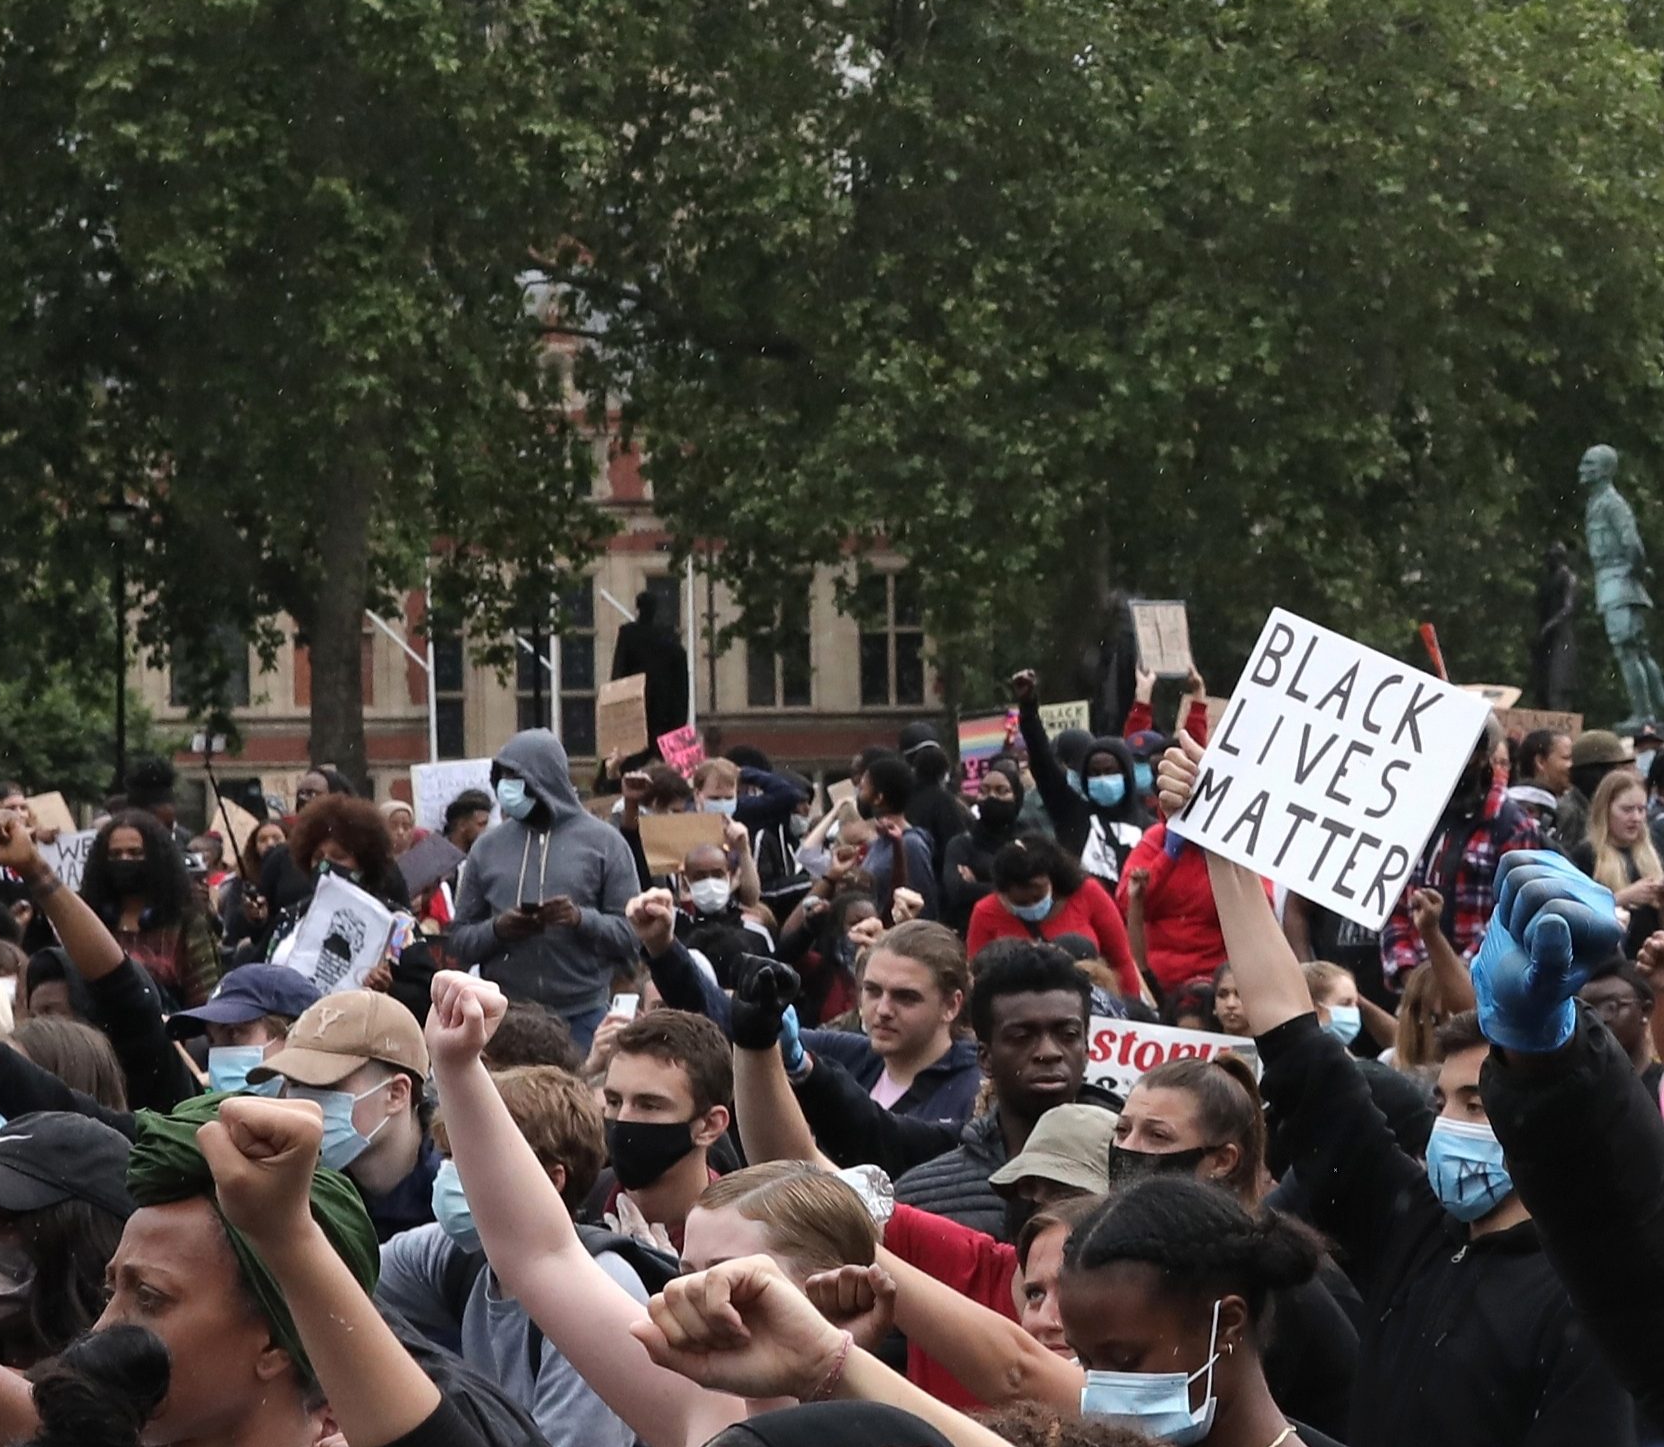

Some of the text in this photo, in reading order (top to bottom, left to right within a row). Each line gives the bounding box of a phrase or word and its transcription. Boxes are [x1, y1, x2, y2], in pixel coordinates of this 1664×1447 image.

[1249, 622, 1446, 754] BLACK
[1218, 696, 1412, 818] LIVES
[1182, 767, 1410, 910] MATTER
